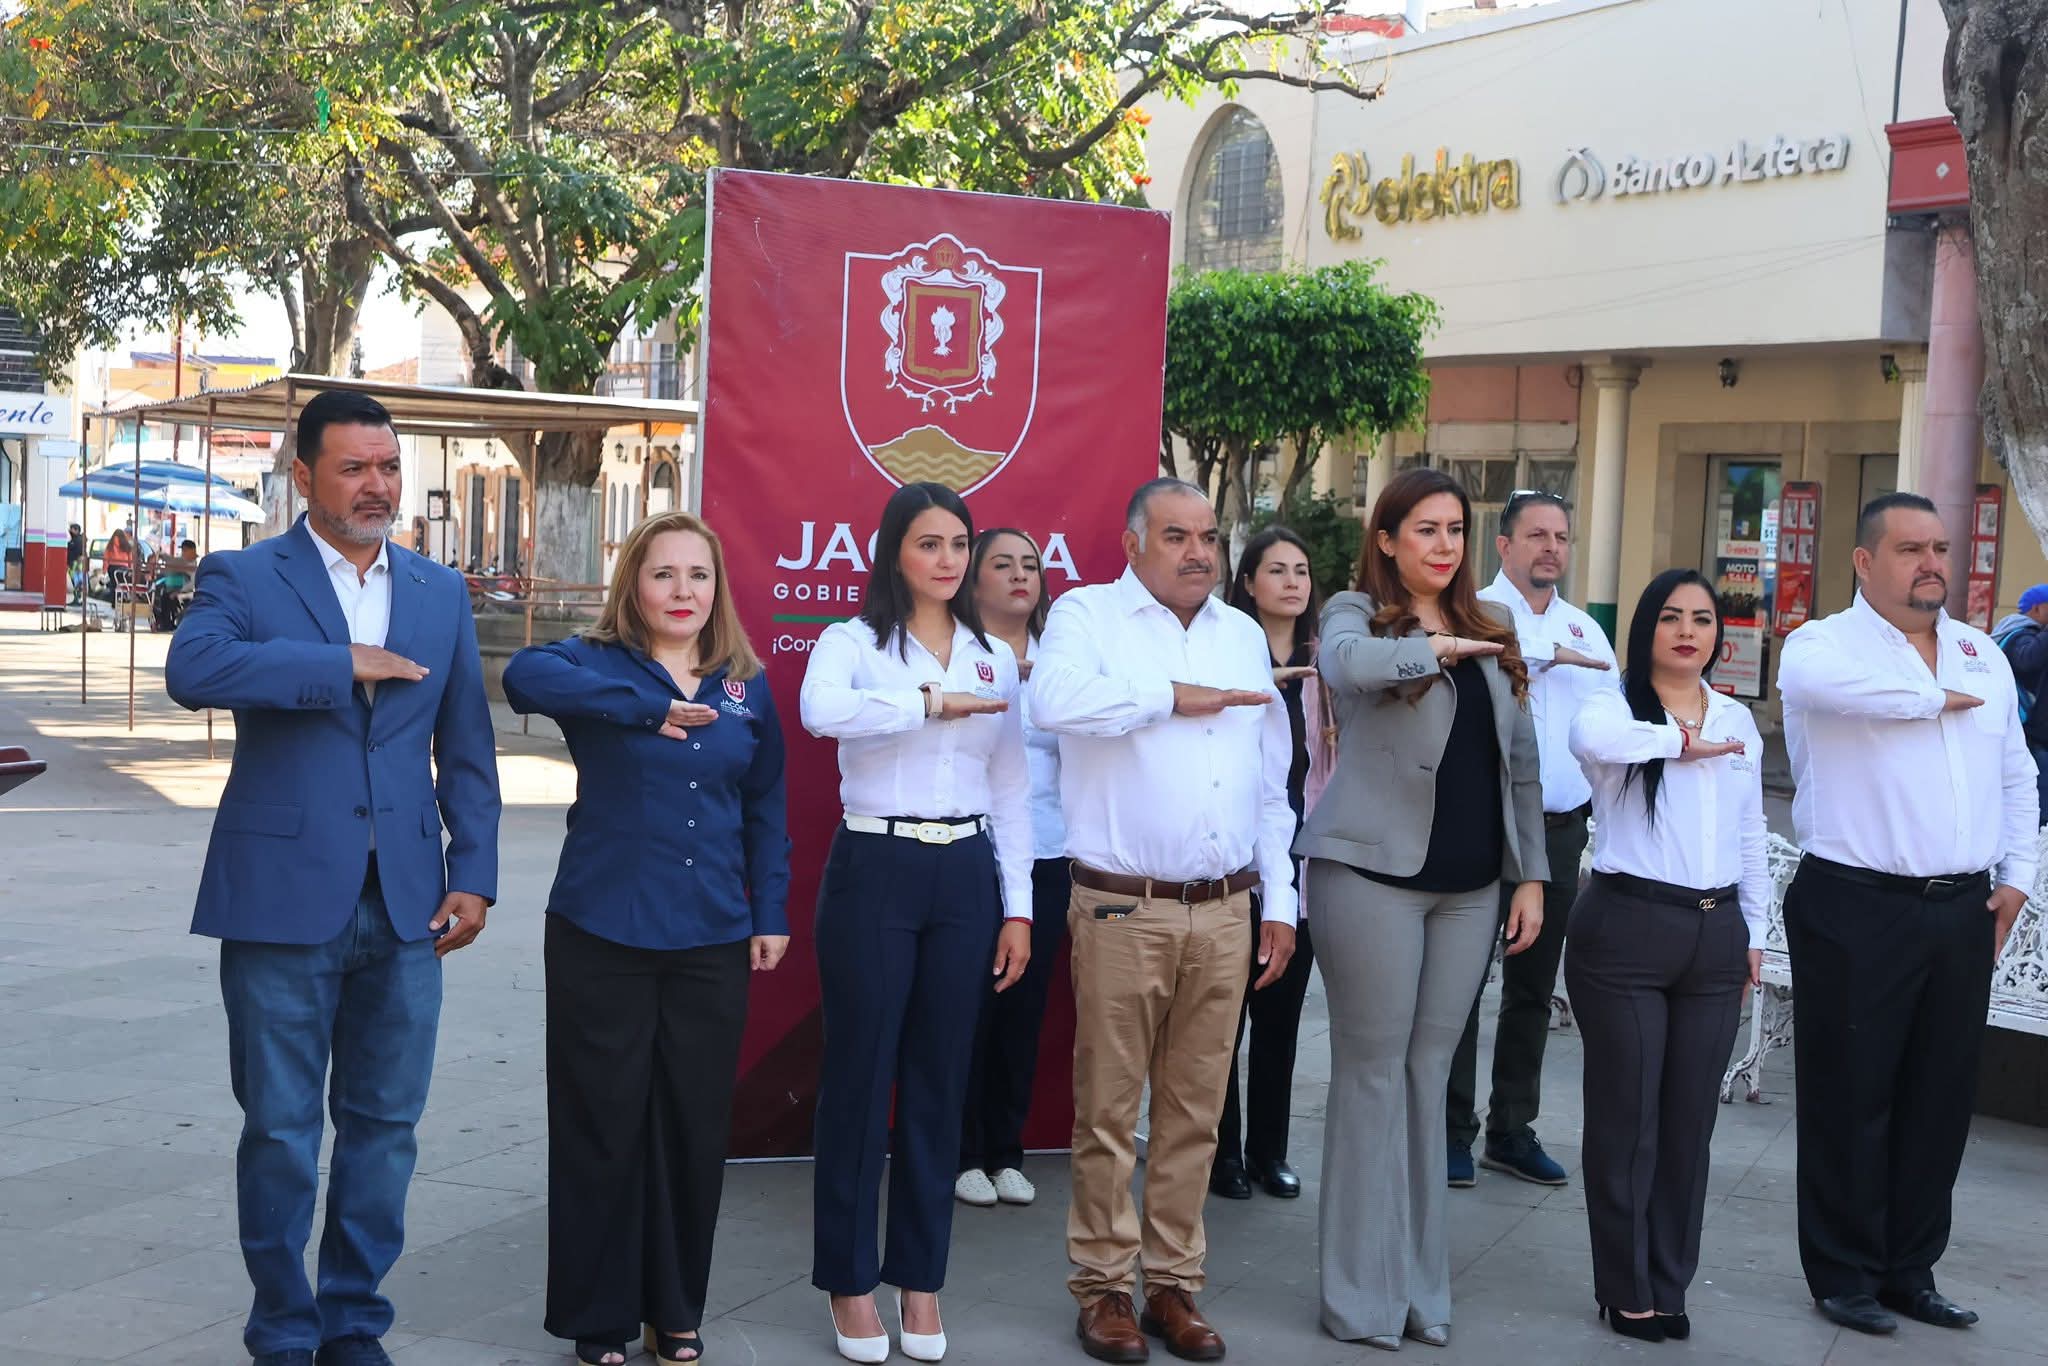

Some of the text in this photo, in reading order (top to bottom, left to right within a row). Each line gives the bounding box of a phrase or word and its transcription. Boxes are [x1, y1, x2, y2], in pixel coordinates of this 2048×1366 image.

[1611, 133, 1852, 197] Banco Azteca
[775, 521, 1082, 581] JAA
[1726, 563, 1756, 573] MOTO
[773, 583, 860, 602] GOBIE
[772, 634, 817, 654] ¡Con
